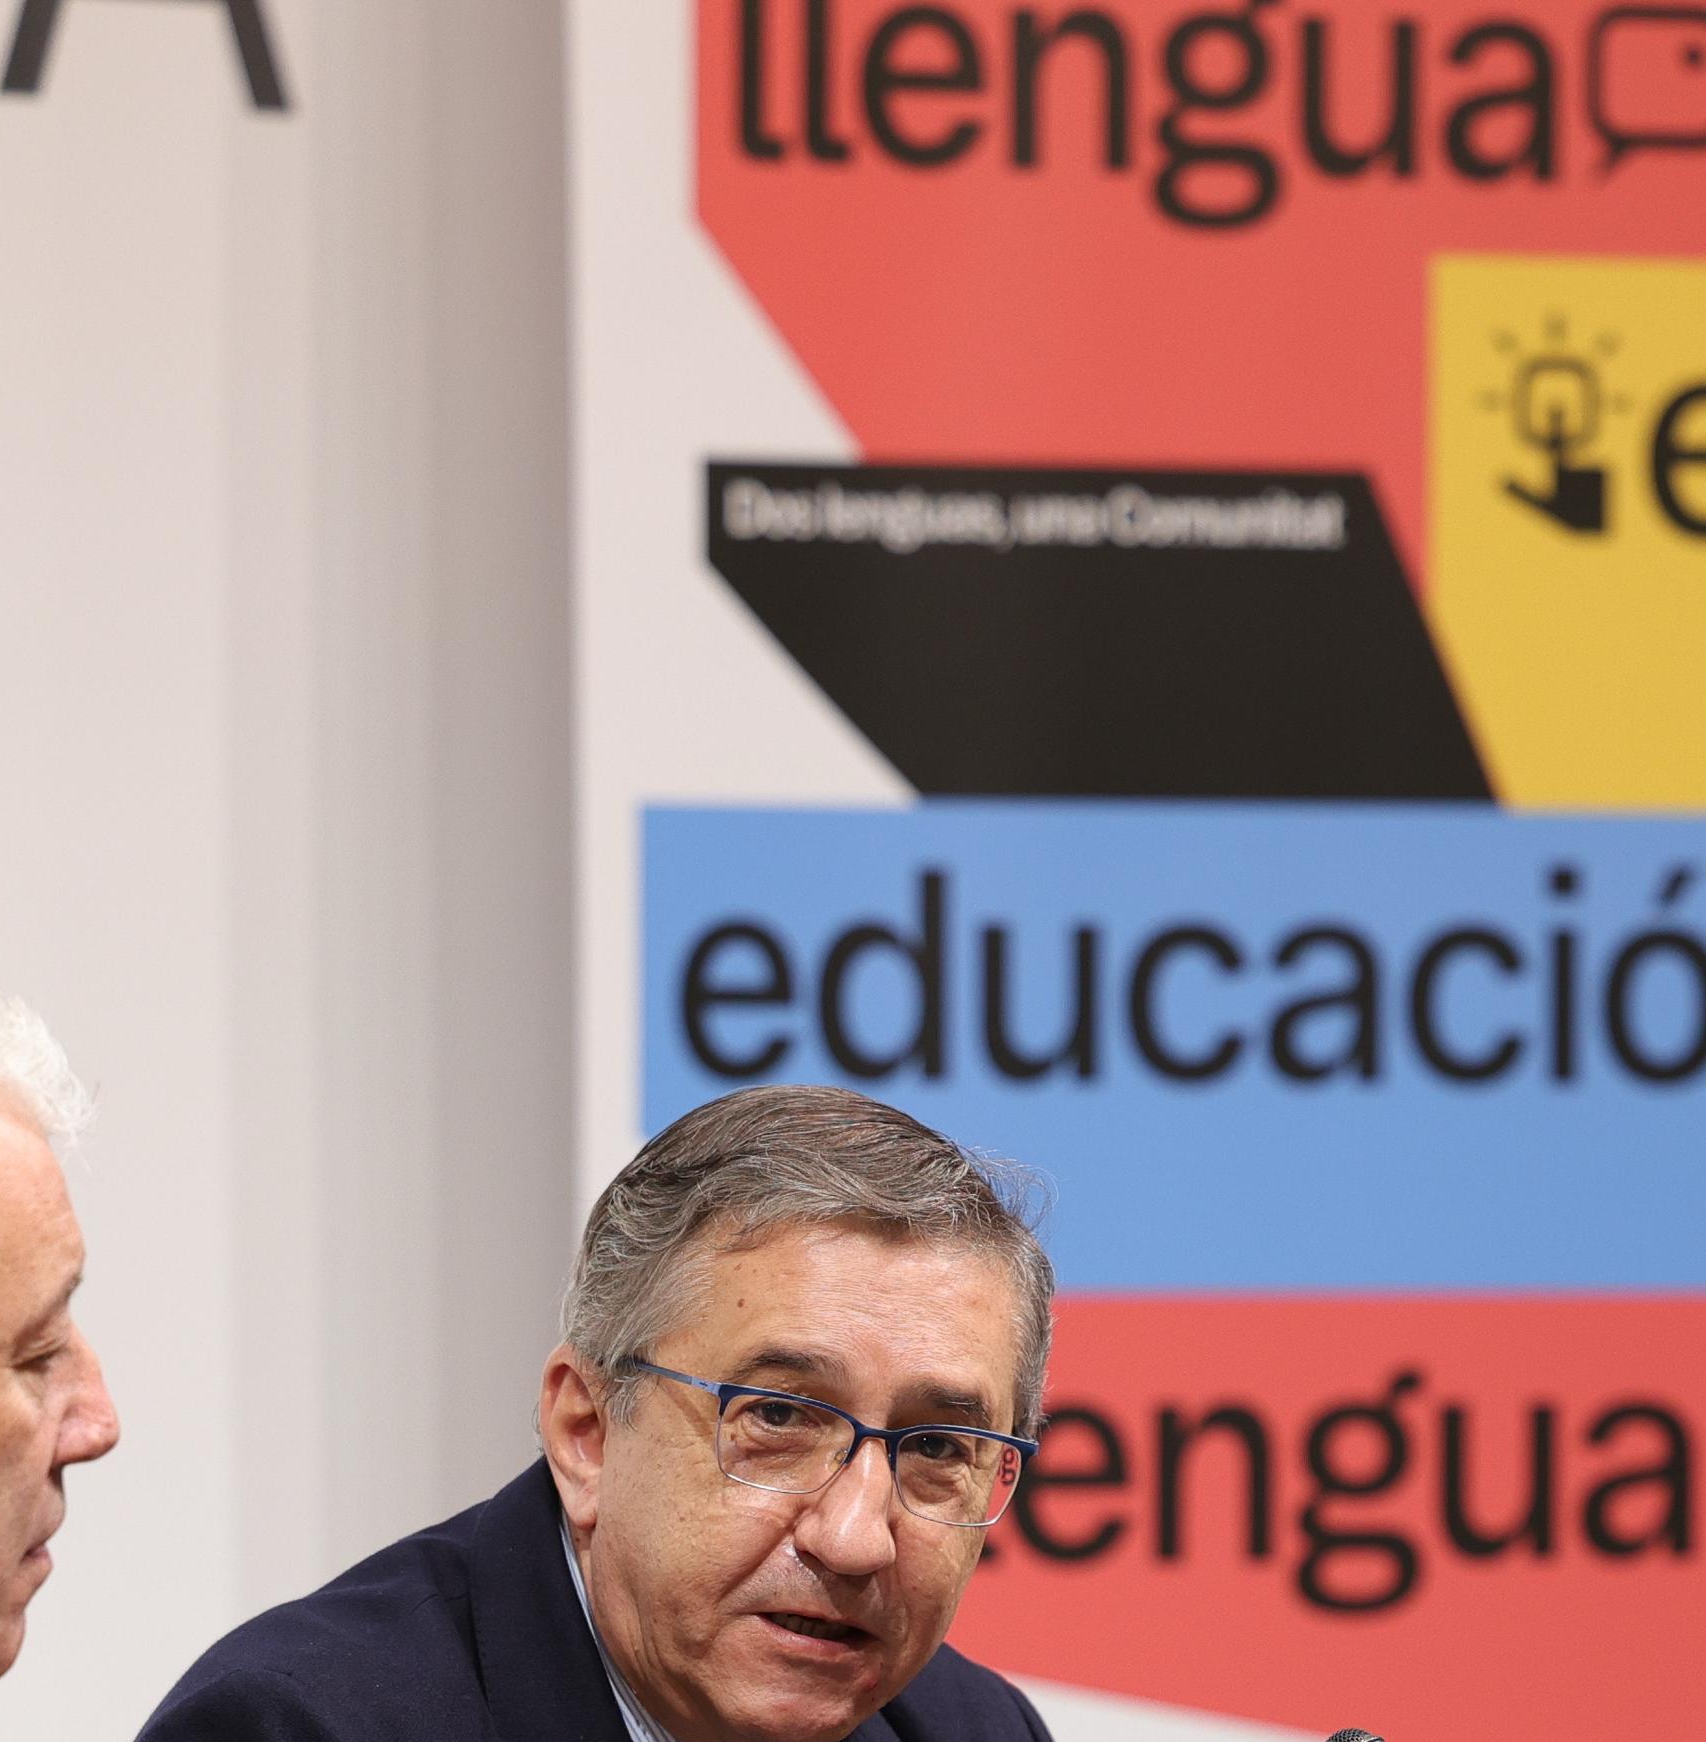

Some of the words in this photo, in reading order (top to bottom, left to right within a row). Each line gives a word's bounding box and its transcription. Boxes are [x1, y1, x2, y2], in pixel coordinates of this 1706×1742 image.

[735, 0, 1560, 232] llengua
[727, 477, 817, 541] Dos
[1015, 489, 1100, 546] una
[1107, 483, 1345, 551] Comunitat
[983, 1366, 1695, 1614] engua
